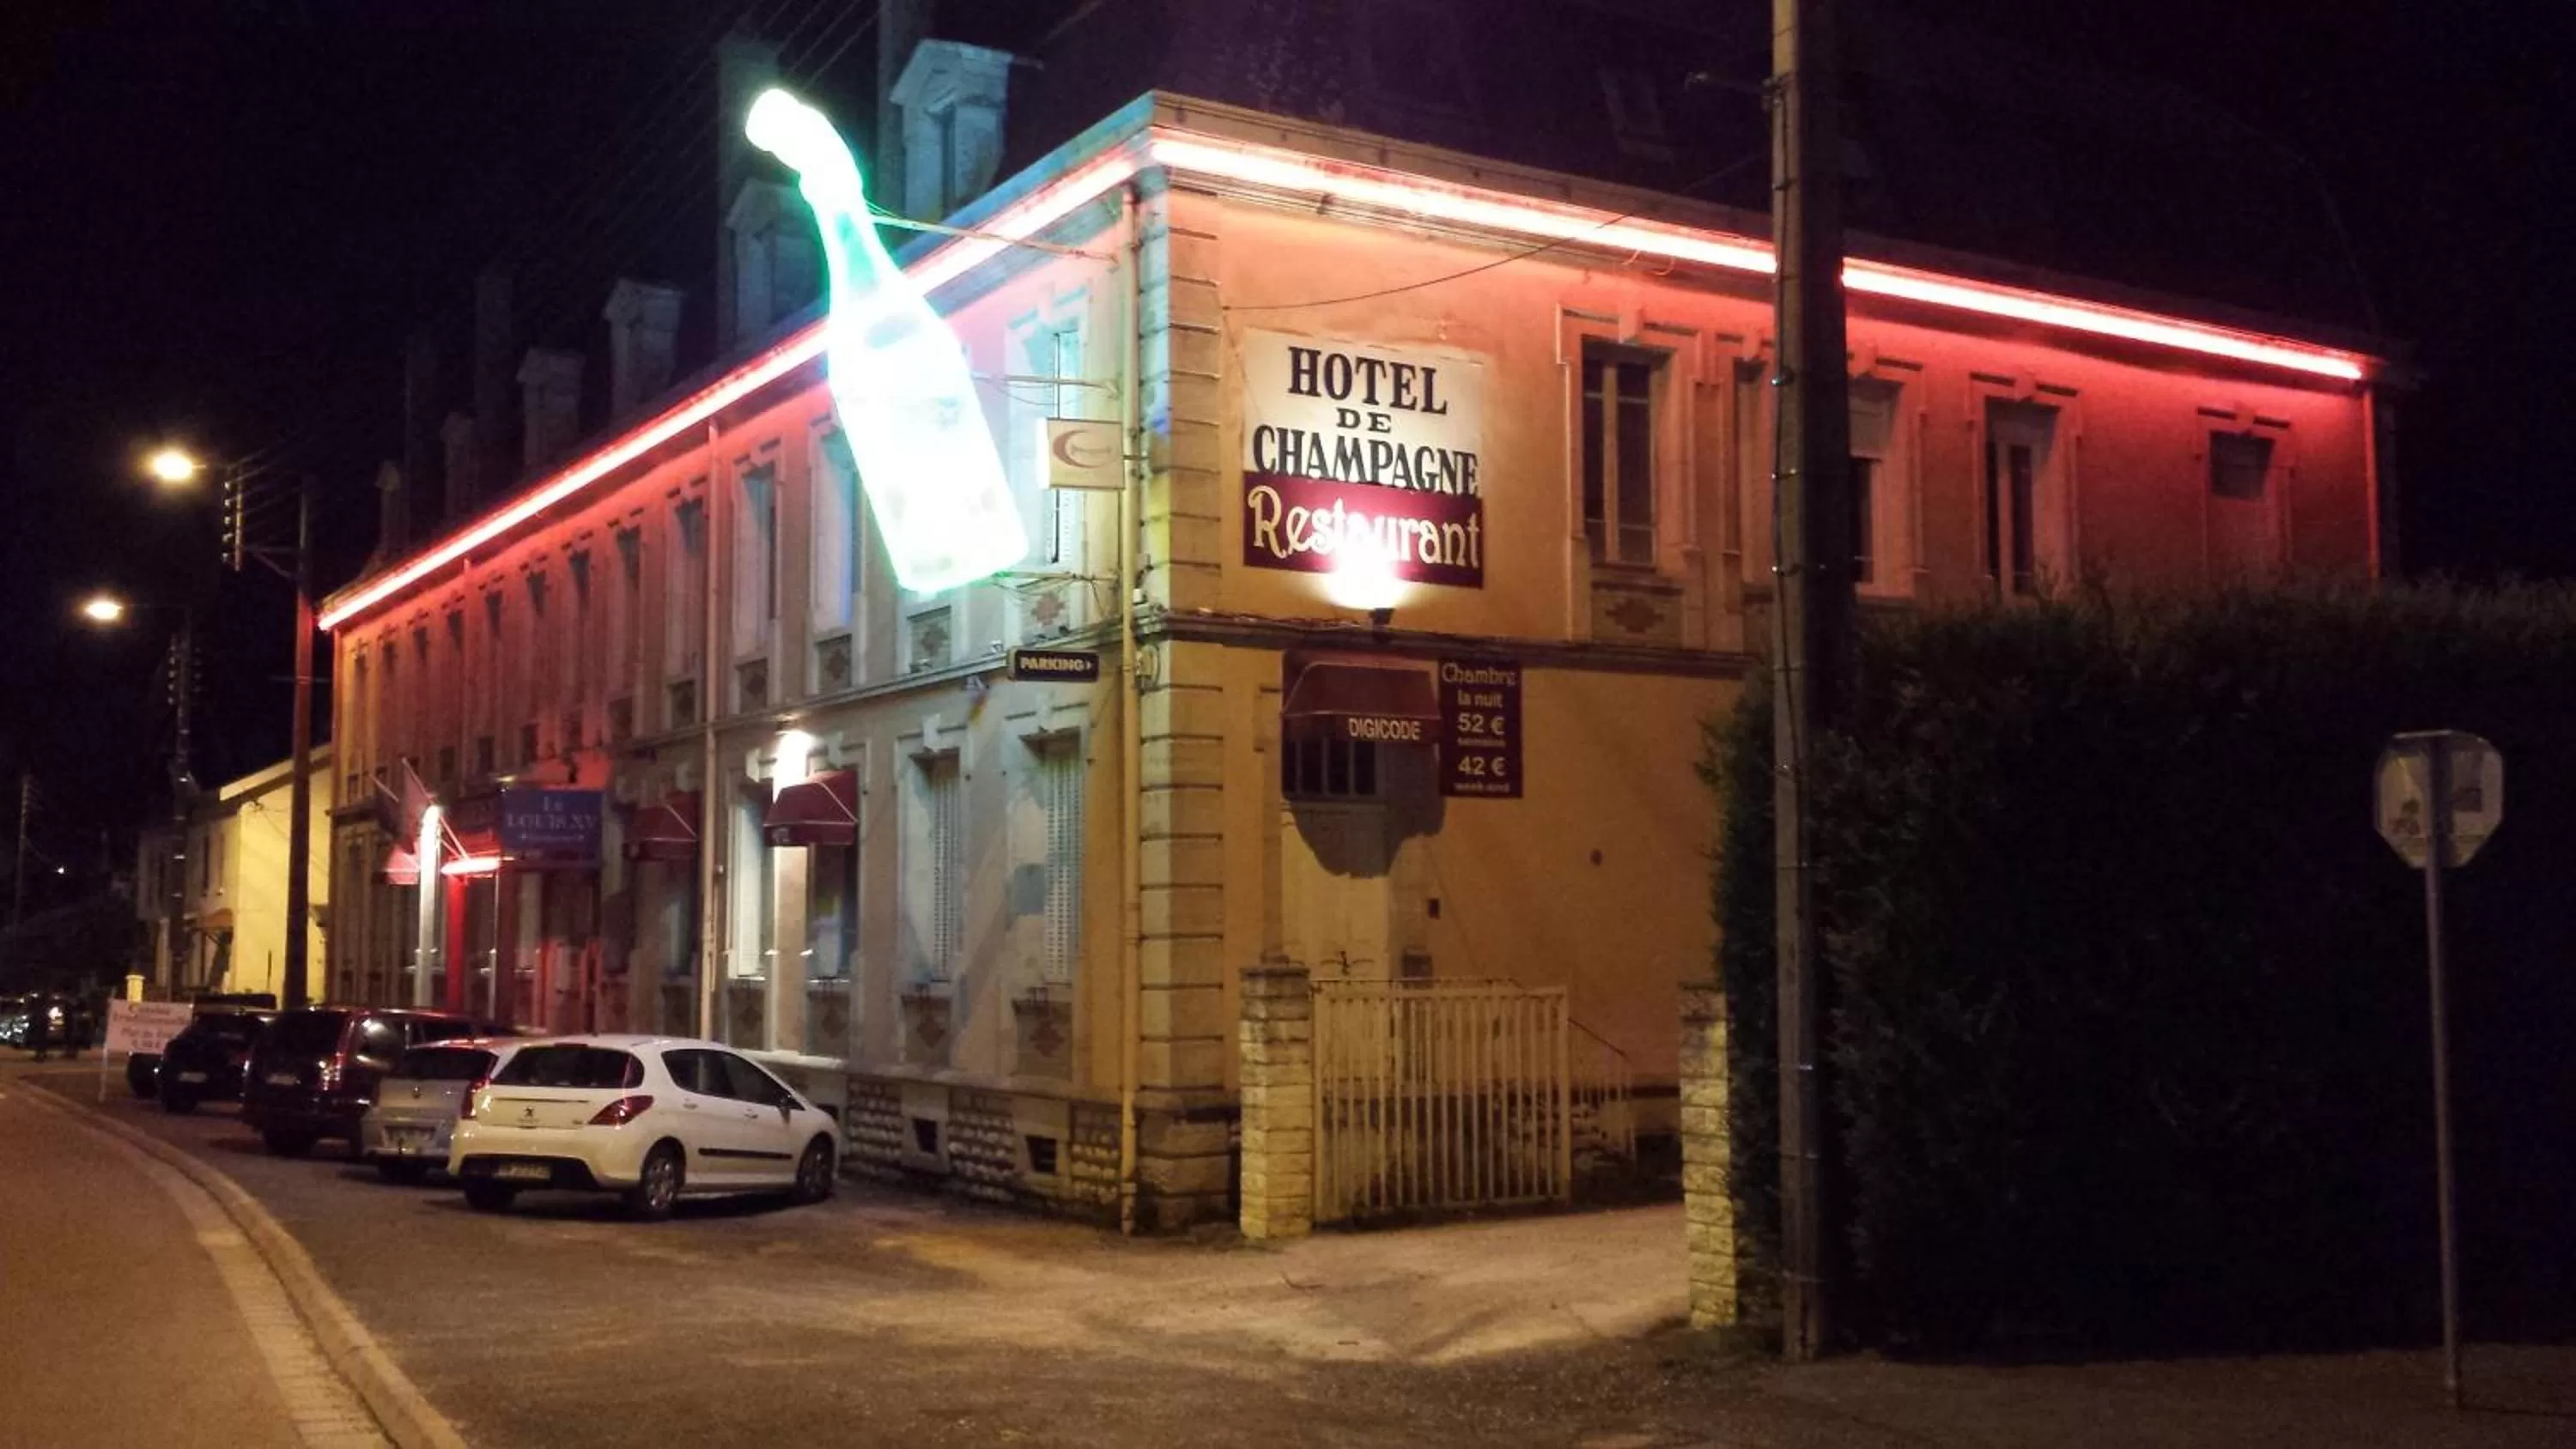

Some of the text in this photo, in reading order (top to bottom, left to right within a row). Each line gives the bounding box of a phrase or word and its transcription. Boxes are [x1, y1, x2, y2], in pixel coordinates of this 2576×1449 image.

[1288, 346, 1448, 415] HOTEL
[1336, 407, 1392, 434] DE
[1253, 424, 1479, 498] CHAMPAGNE
[1019, 656, 1084, 672] PARKING
[1443, 662, 1516, 687] Chambre
[1457, 689, 1504, 708] la nuit
[1348, 717, 1422, 741] DIGICODE
[1457, 712, 1505, 736] 52 €
[1458, 755, 1505, 777] 42 €
